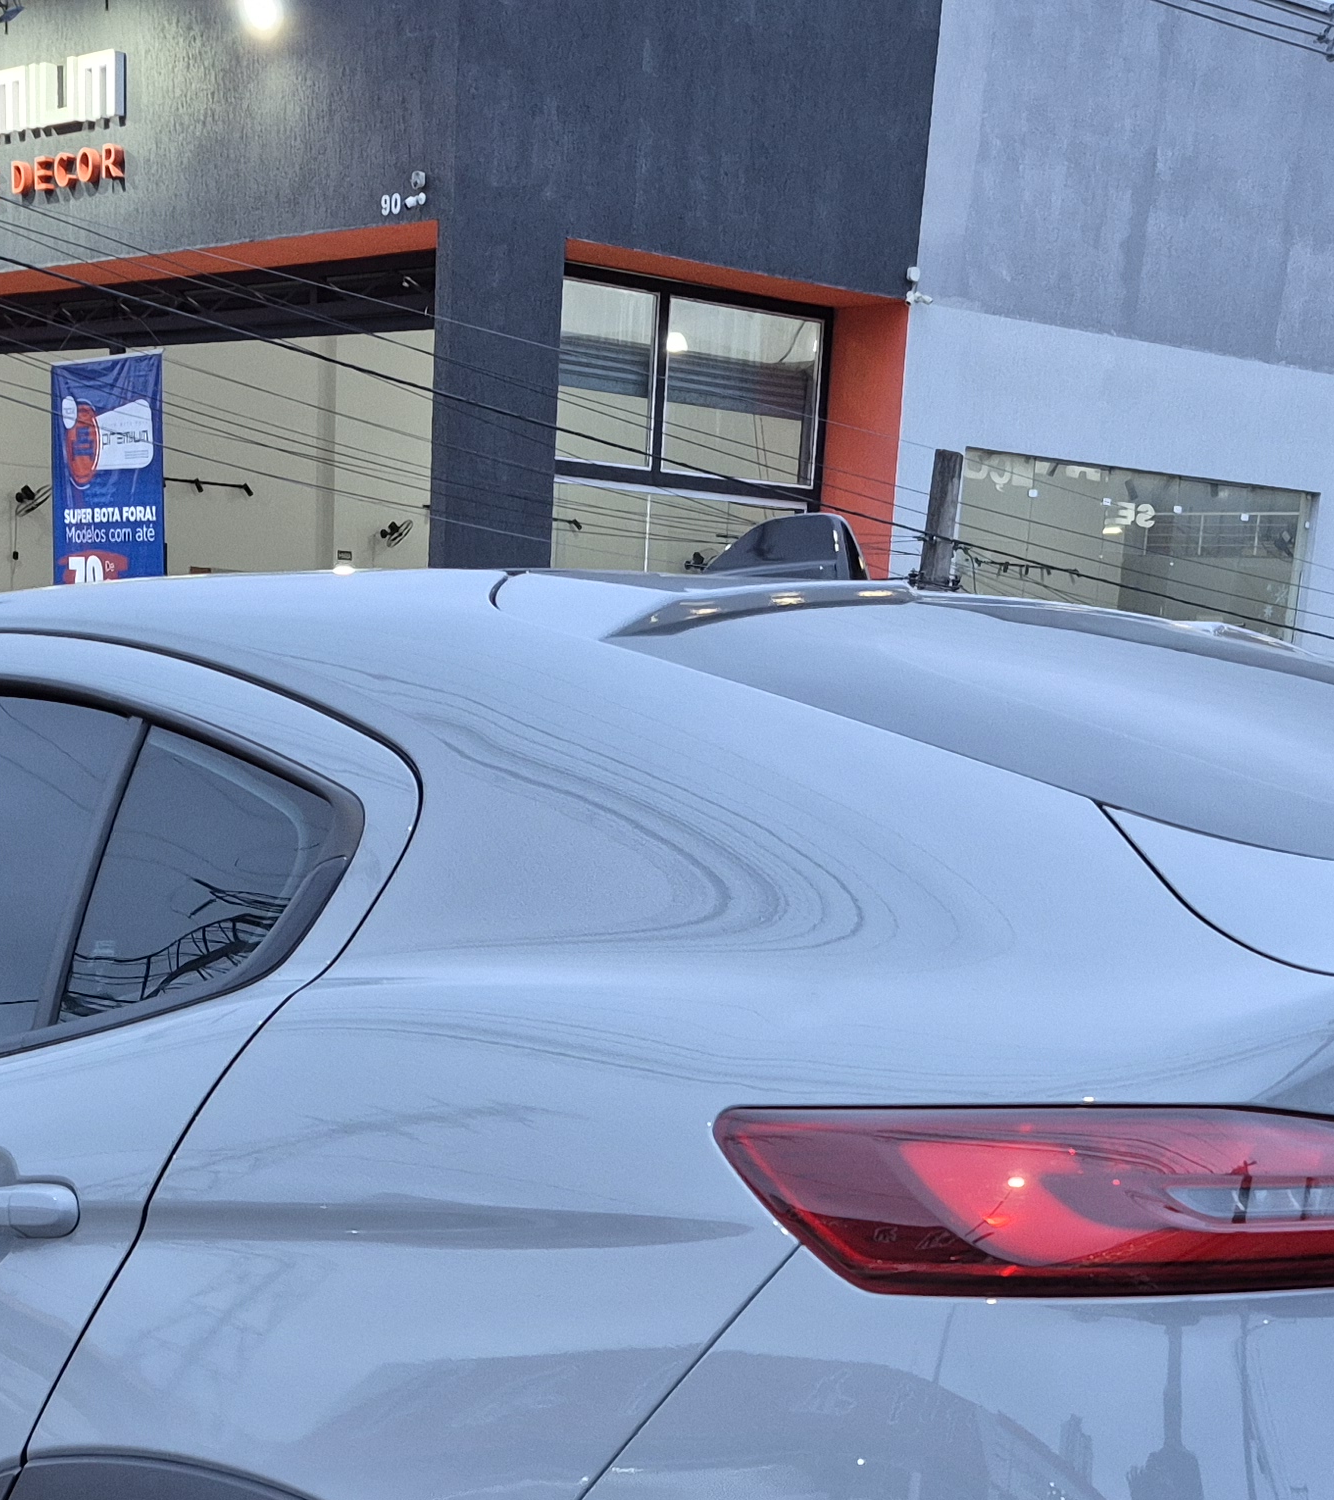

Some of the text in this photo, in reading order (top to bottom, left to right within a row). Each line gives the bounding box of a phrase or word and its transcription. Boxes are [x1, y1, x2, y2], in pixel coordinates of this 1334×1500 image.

[11, 143, 125, 195] DECOR
[381, 193, 401, 216] 90
[64, 505, 157, 524] SUPER BOTA FORA!
[65, 523, 156, 543] Modelos com até
